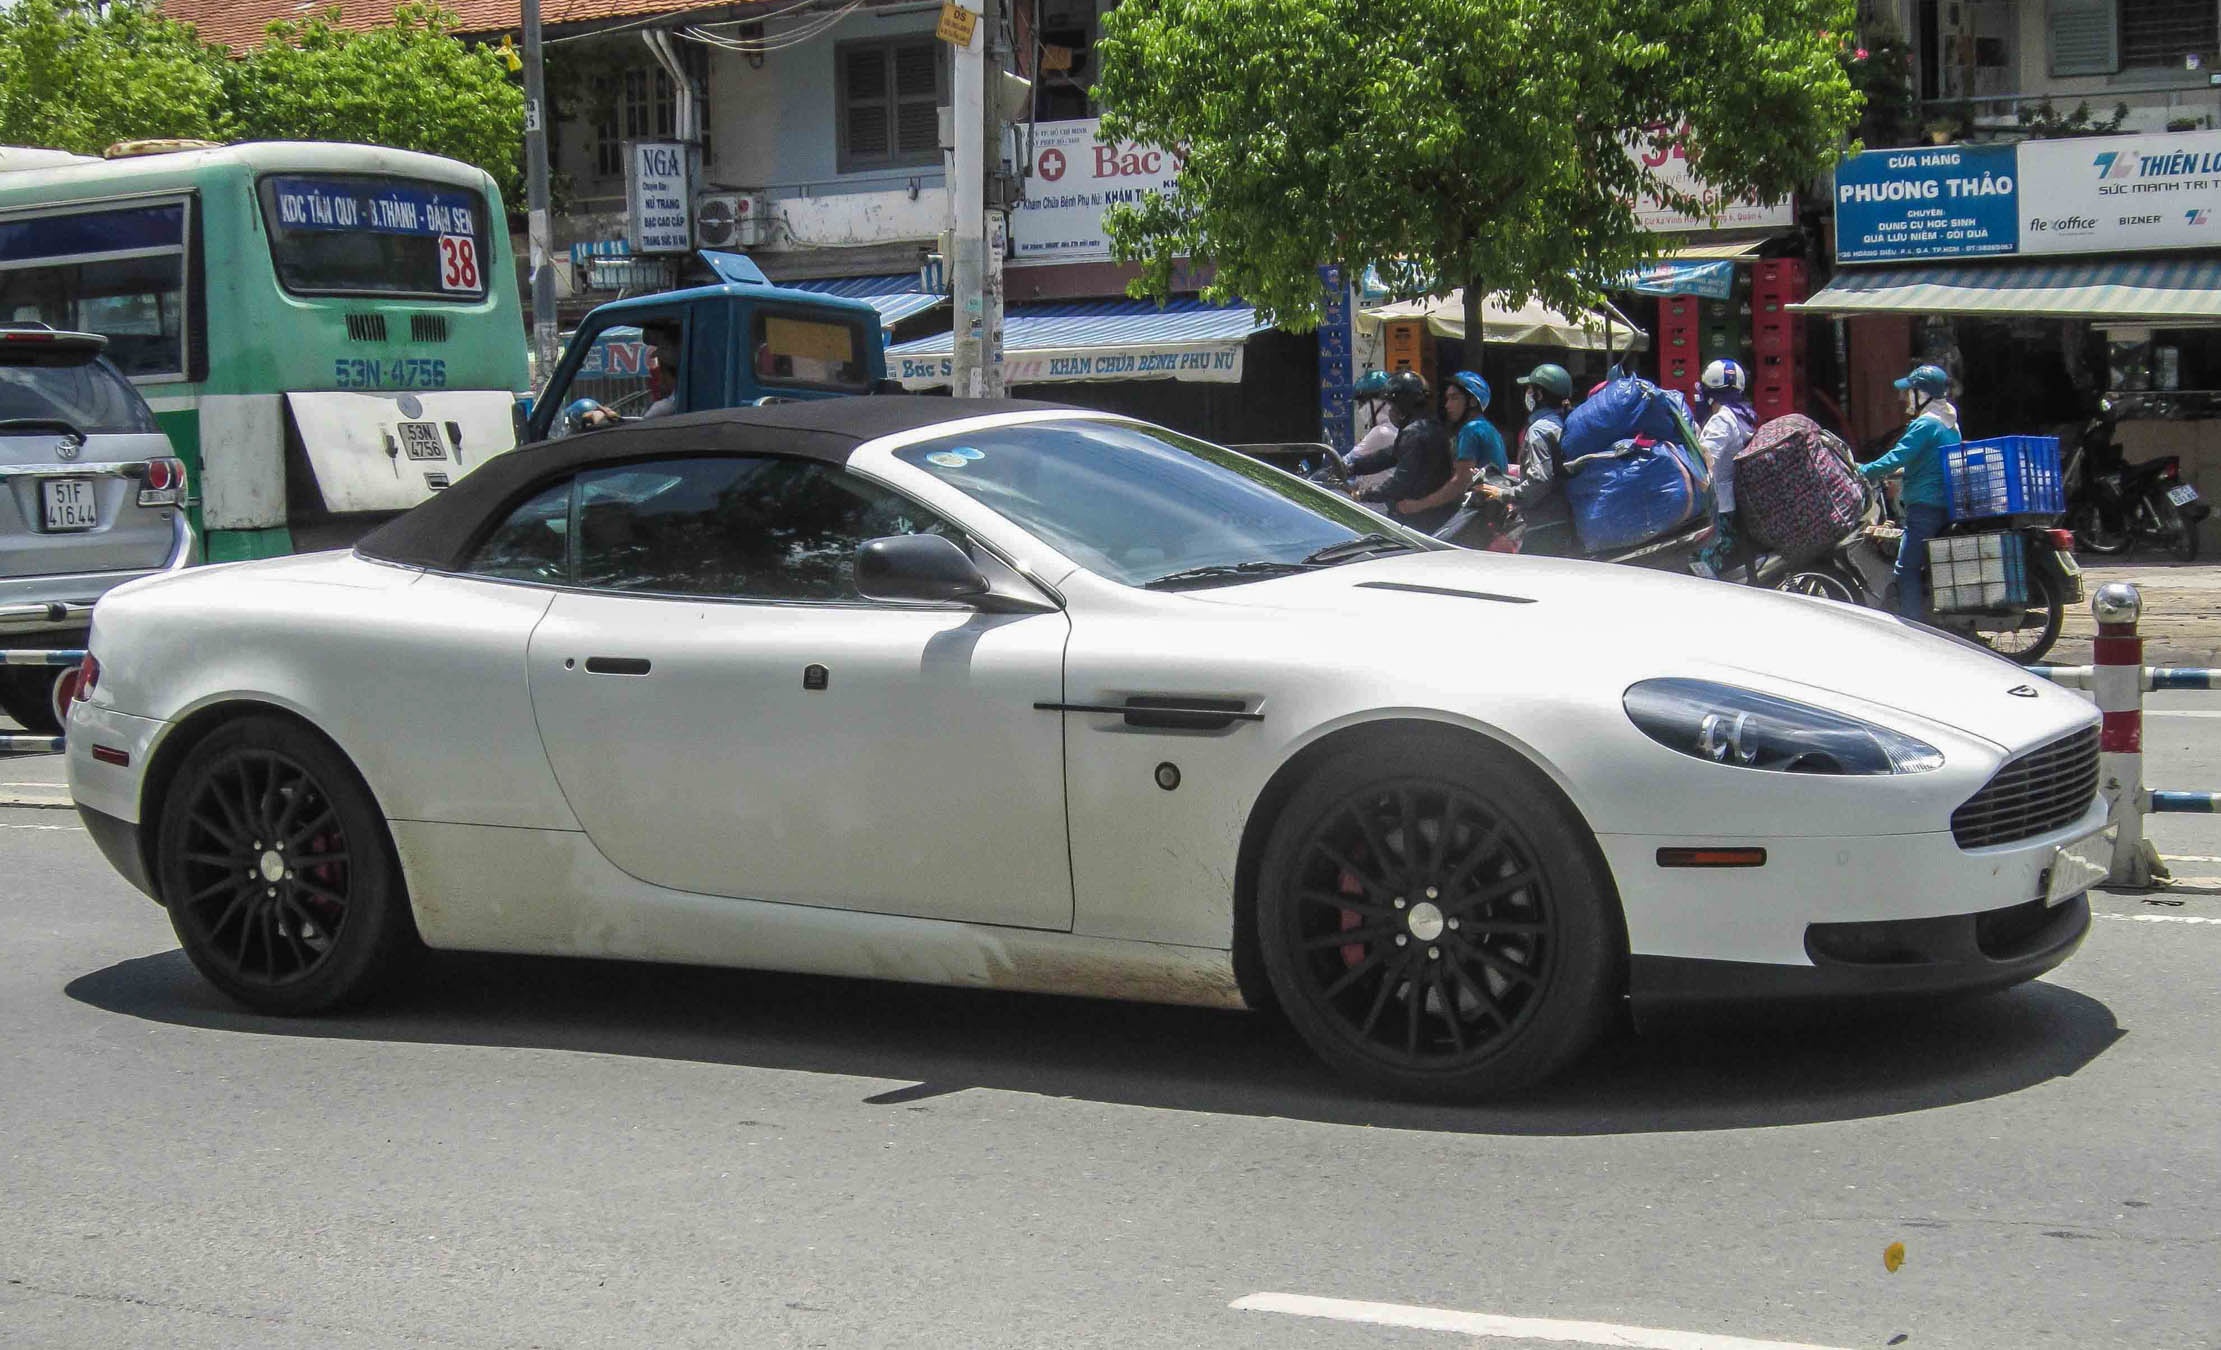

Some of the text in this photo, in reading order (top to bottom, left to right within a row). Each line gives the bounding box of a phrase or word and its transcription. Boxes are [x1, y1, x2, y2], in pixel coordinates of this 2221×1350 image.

[642, 149, 681, 177] NGA
[1092, 142, 1162, 179] Bác
[1921, 153, 1961, 167] HÀNG
[2140, 149, 2200, 178] THIÊN
[1105, 187, 1133, 204] KHÁM
[1840, 170, 2013, 203] PHƯƠNG THẢO
[280, 194, 306, 223] KDC
[309, 188, 334, 224] TÂN
[335, 197, 358, 225] QUY
[453, 208, 475, 235] SEN
[656, 198, 680, 209] TRANG
[657, 216, 671, 227] CAO
[1950, 218, 1976, 227] SINH
[2119, 215, 2161, 226] BIZNER
[442, 238, 477, 288] 38
[902, 358, 936, 378] Bác
[1049, 353, 1091, 375] KHÁM
[1138, 350, 1179, 375] BỆNH
[1180, 351, 1211, 374] PHỤ
[411, 441, 442, 457] 4756
[56, 483, 82, 503] 51F
[49, 505, 95, 526] 416.44
